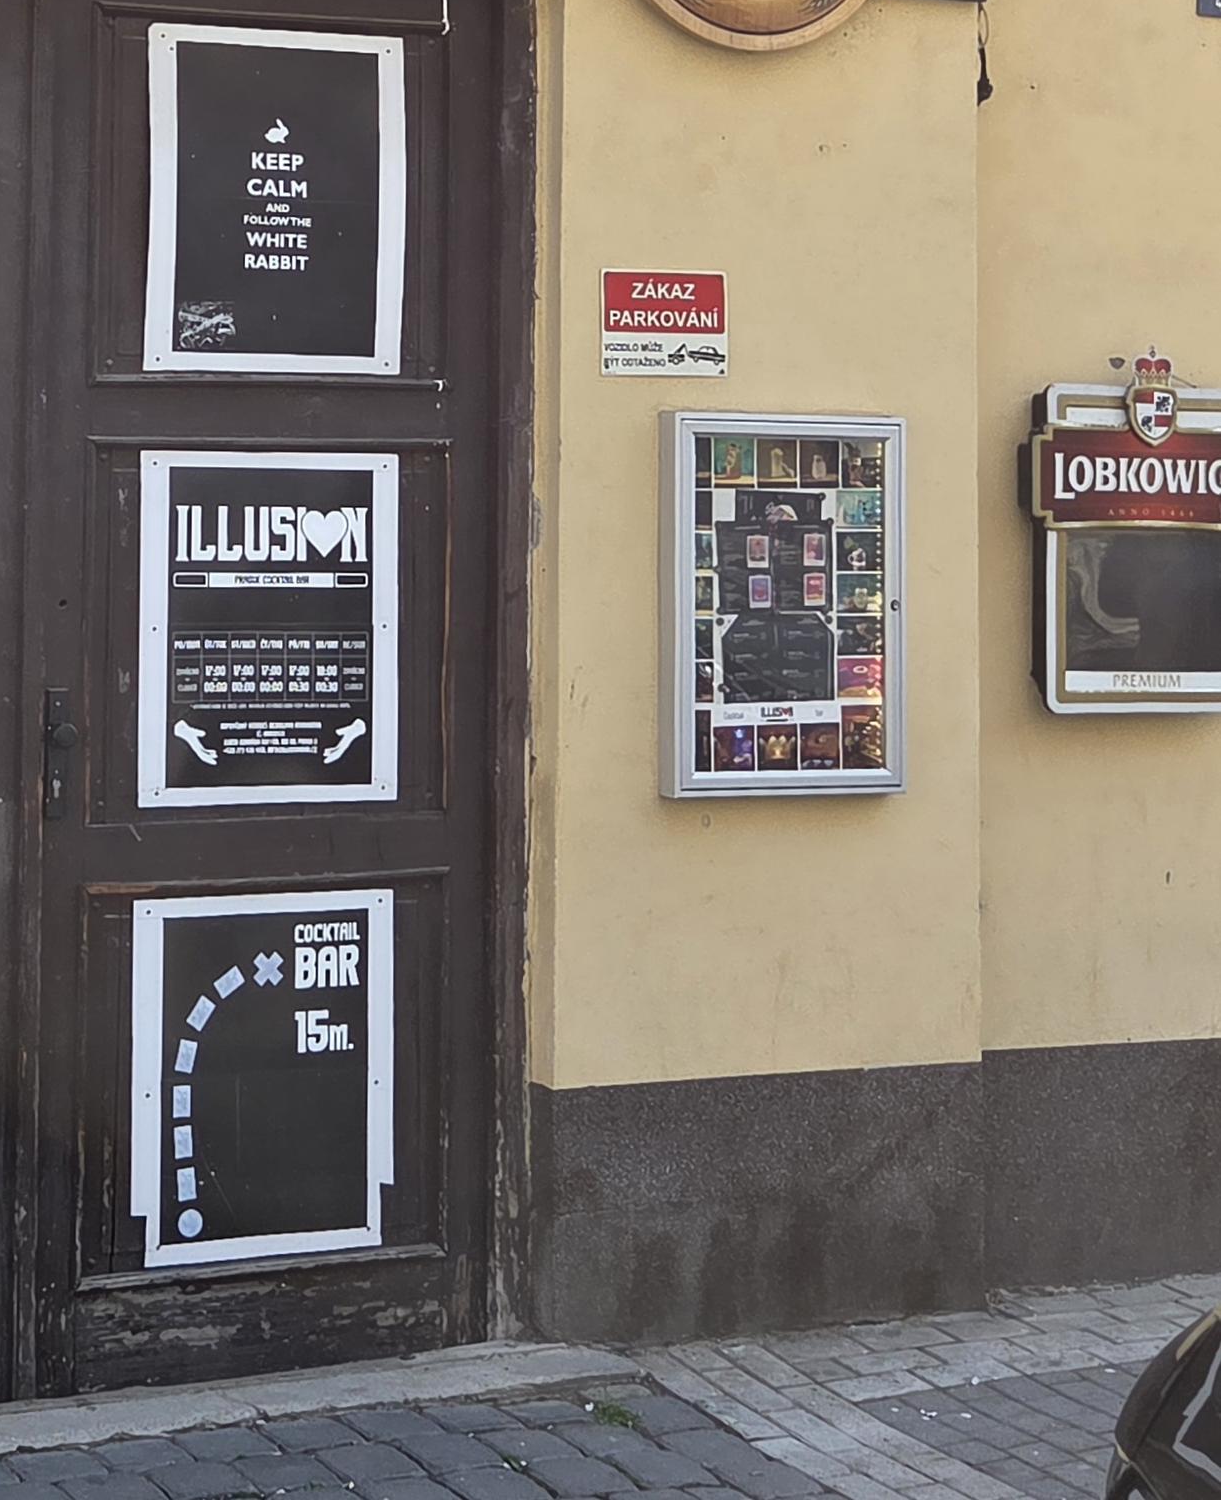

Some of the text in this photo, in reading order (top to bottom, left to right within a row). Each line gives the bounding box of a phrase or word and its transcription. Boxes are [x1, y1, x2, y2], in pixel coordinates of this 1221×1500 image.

[251, 151, 304, 171] KEEP
[246, 178, 307, 198] CALM
[265, 202, 290, 213] AND
[243, 214, 312, 228] FOLLOW THE
[246, 231, 308, 249] WHITE
[244, 253, 309, 271] RABBIT
[631, 278, 696, 301] ZÁKAZ
[608, 306, 719, 328] PARKOVÁNÍ
[1112, 673, 1182, 689] PREMIUM
[294, 921, 361, 943] COCKTAIL
[294, 944, 360, 989] BAR
[294, 1009, 355, 1053] 15m.
